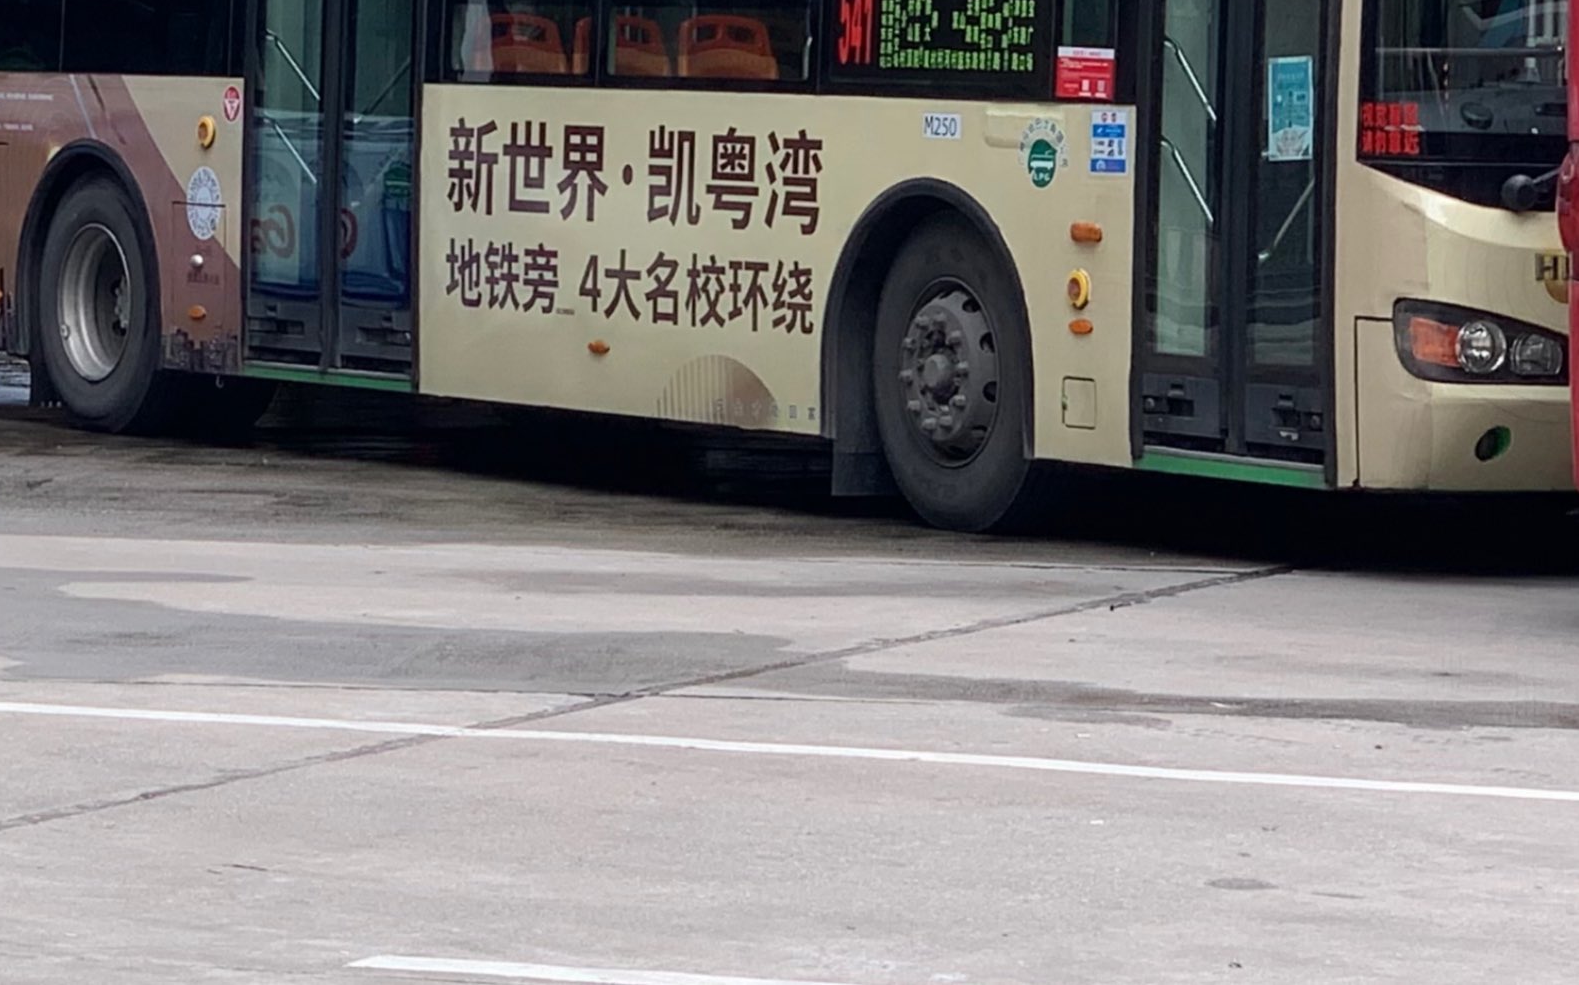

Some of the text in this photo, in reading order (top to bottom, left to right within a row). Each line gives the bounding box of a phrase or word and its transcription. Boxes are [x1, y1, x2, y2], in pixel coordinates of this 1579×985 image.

[924, 116, 958, 137] M250
[446, 237, 815, 335] 地铁旁 4大名校环绕
